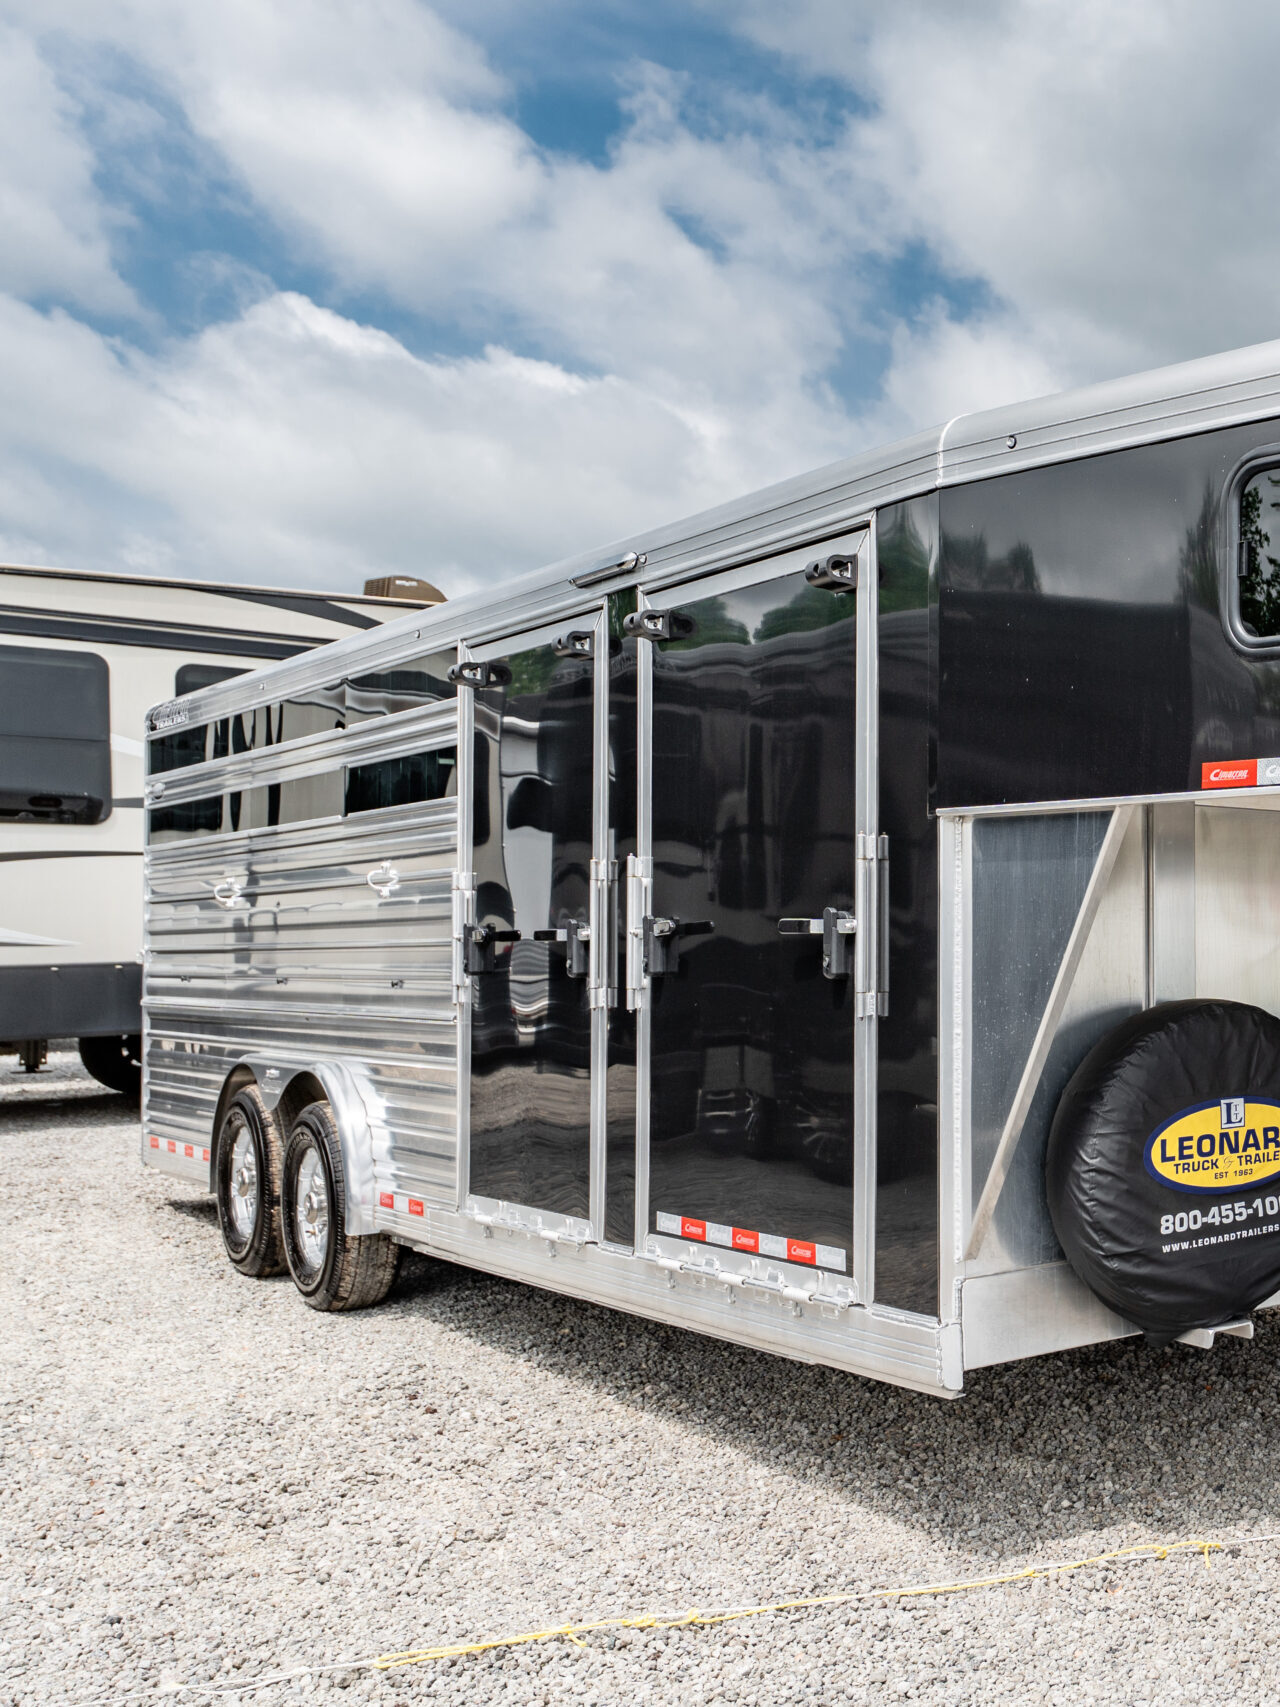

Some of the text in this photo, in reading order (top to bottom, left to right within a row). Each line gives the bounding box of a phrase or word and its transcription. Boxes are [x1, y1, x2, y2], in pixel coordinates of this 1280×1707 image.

[1174, 1159, 1219, 1175] TRUCK
[1214, 1168, 1253, 1180] EST 1963
